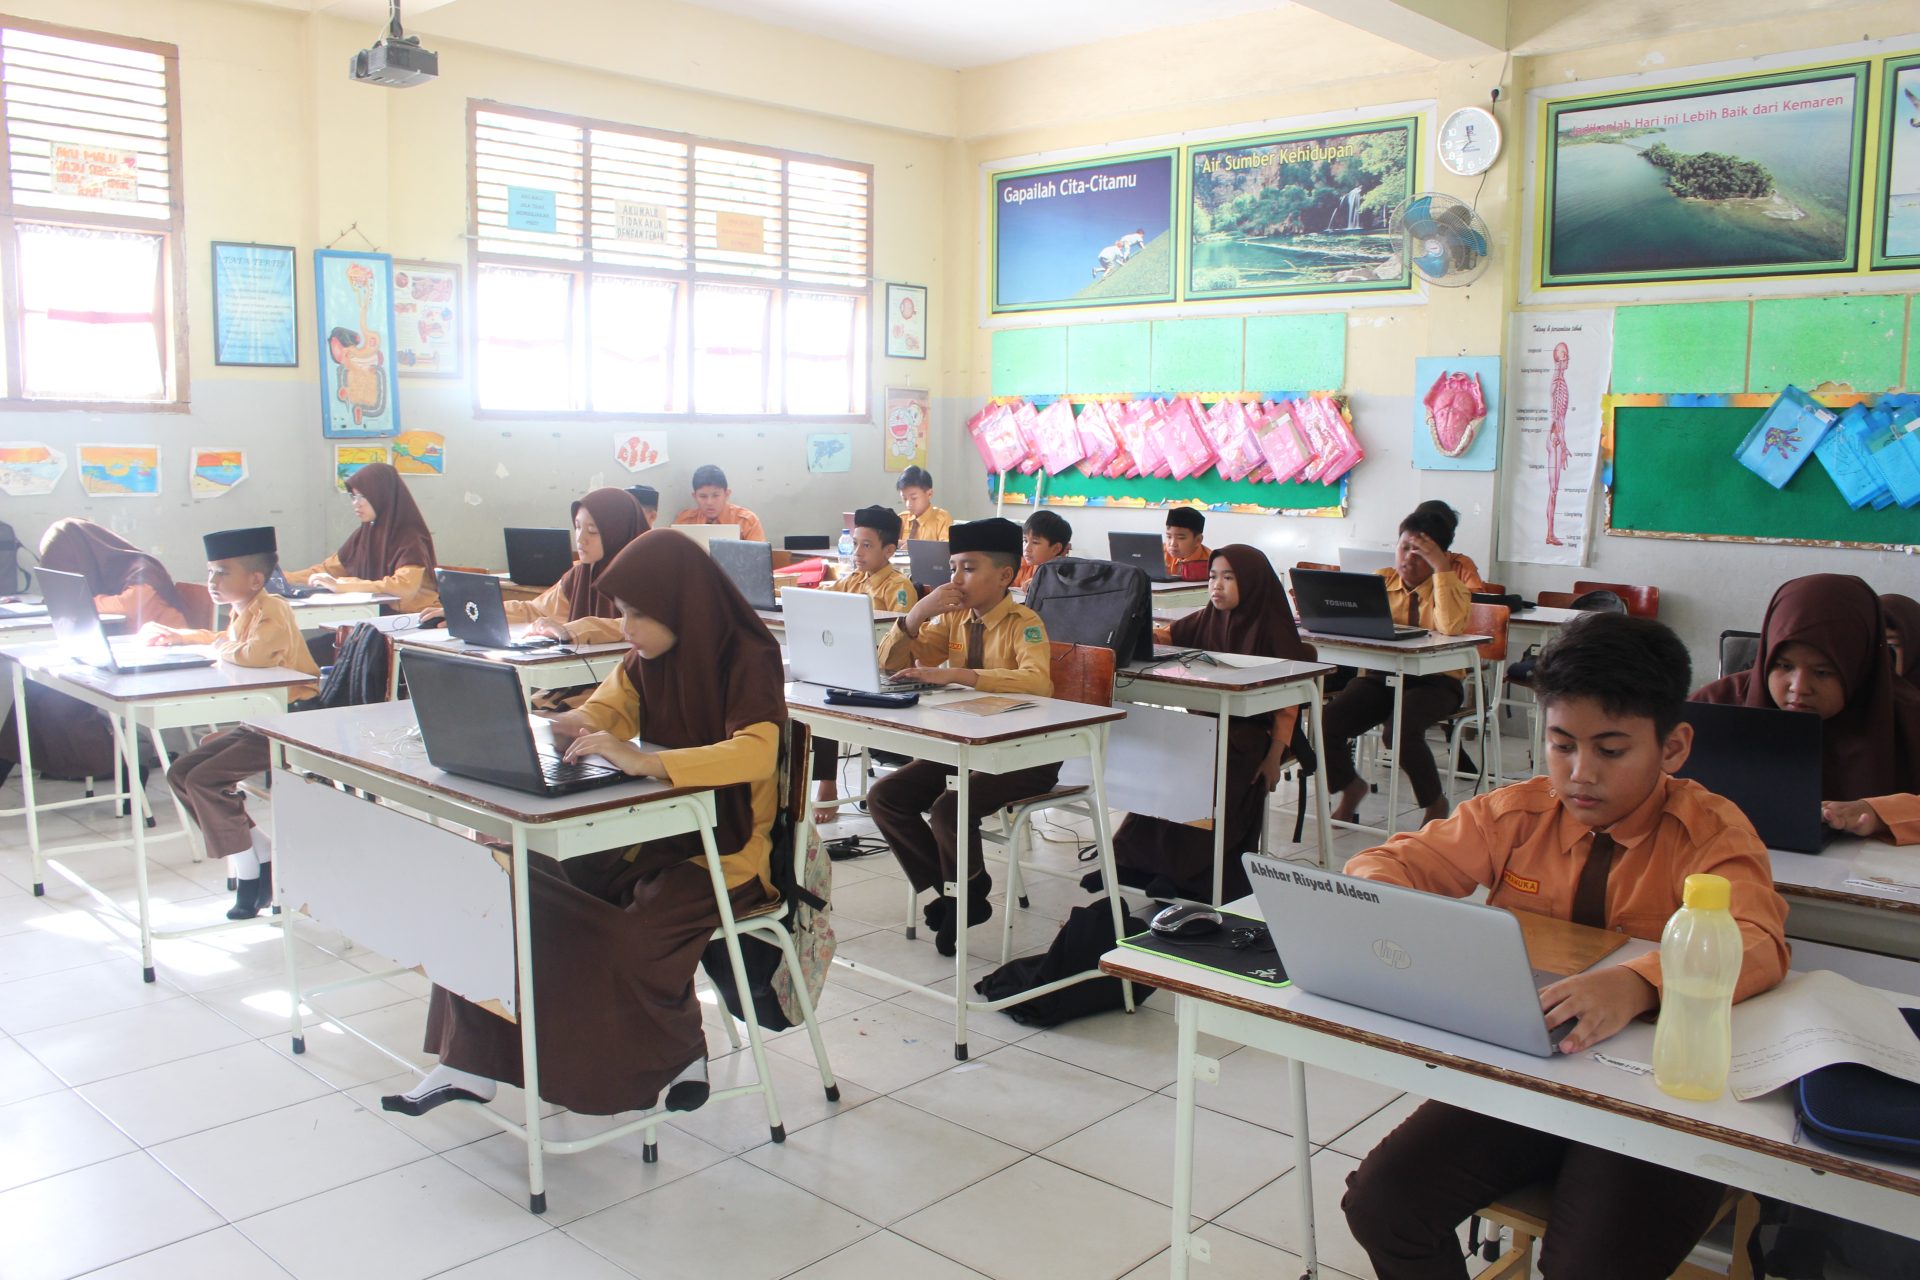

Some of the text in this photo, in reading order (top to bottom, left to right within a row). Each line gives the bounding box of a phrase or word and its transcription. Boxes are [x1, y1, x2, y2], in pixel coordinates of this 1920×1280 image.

[1635, 116, 1660, 129] Hari
[1663, 113, 1679, 125] ini
[1683, 108, 1717, 123] Lebih
[1722, 105, 1749, 119] Baik
[1753, 102, 1779, 115] dari
[1783, 95, 1844, 112] Kemaren
[1203, 143, 1354, 174] Air Sumber Kehidupan
[1004, 173, 1138, 205] Gapailah Cita-Citamu
[1324, 599, 1358, 609] TOSHIBA
[1251, 861, 1380, 904] Akhtar Risyad Aldean
